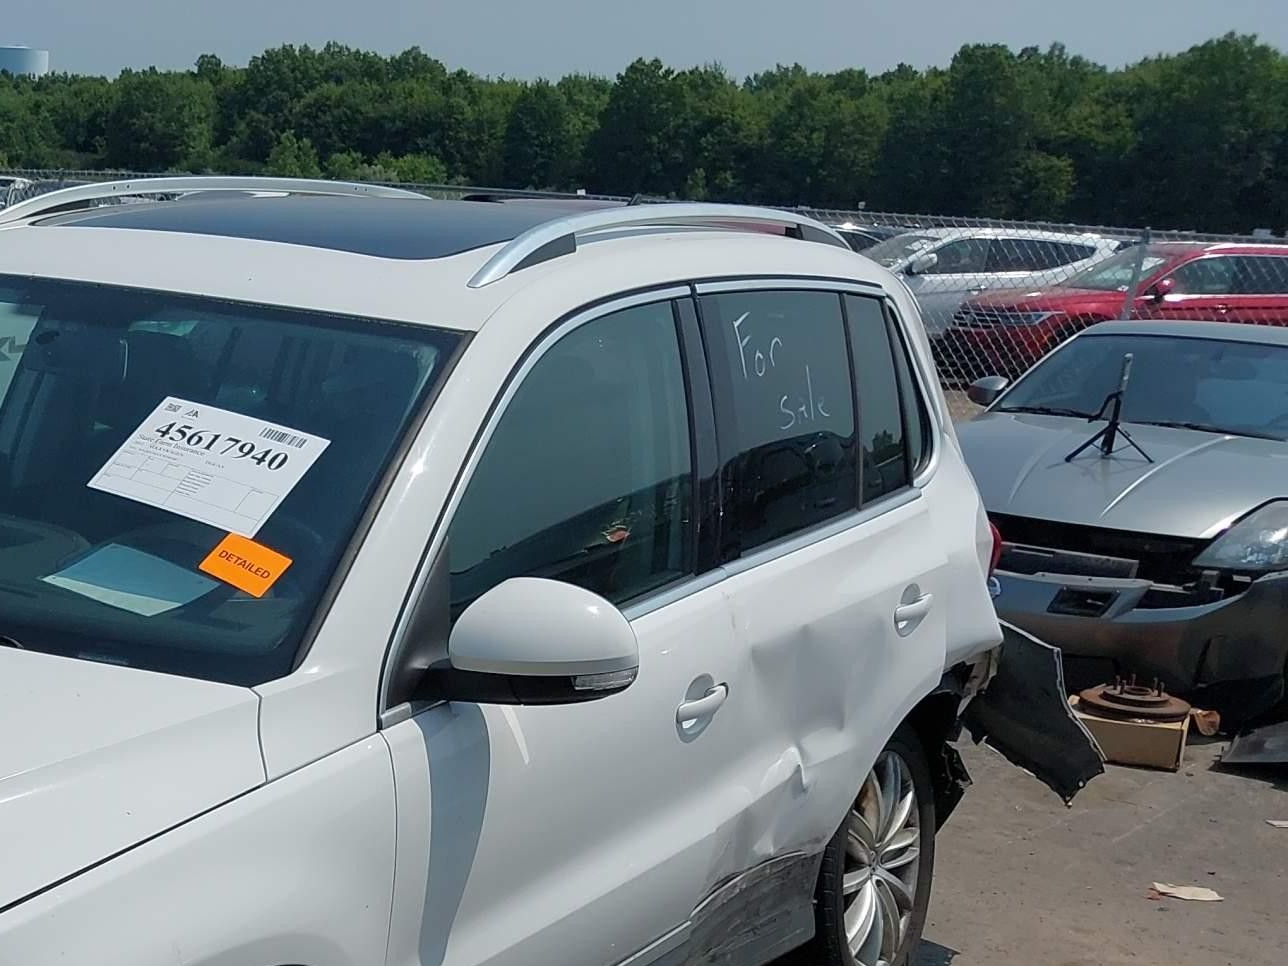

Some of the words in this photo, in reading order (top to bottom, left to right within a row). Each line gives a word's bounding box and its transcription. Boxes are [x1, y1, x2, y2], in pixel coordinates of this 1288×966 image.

[732, 311, 783, 380] For
[155, 421, 289, 471] 45617940
[218, 549, 271, 580] DETAILED
